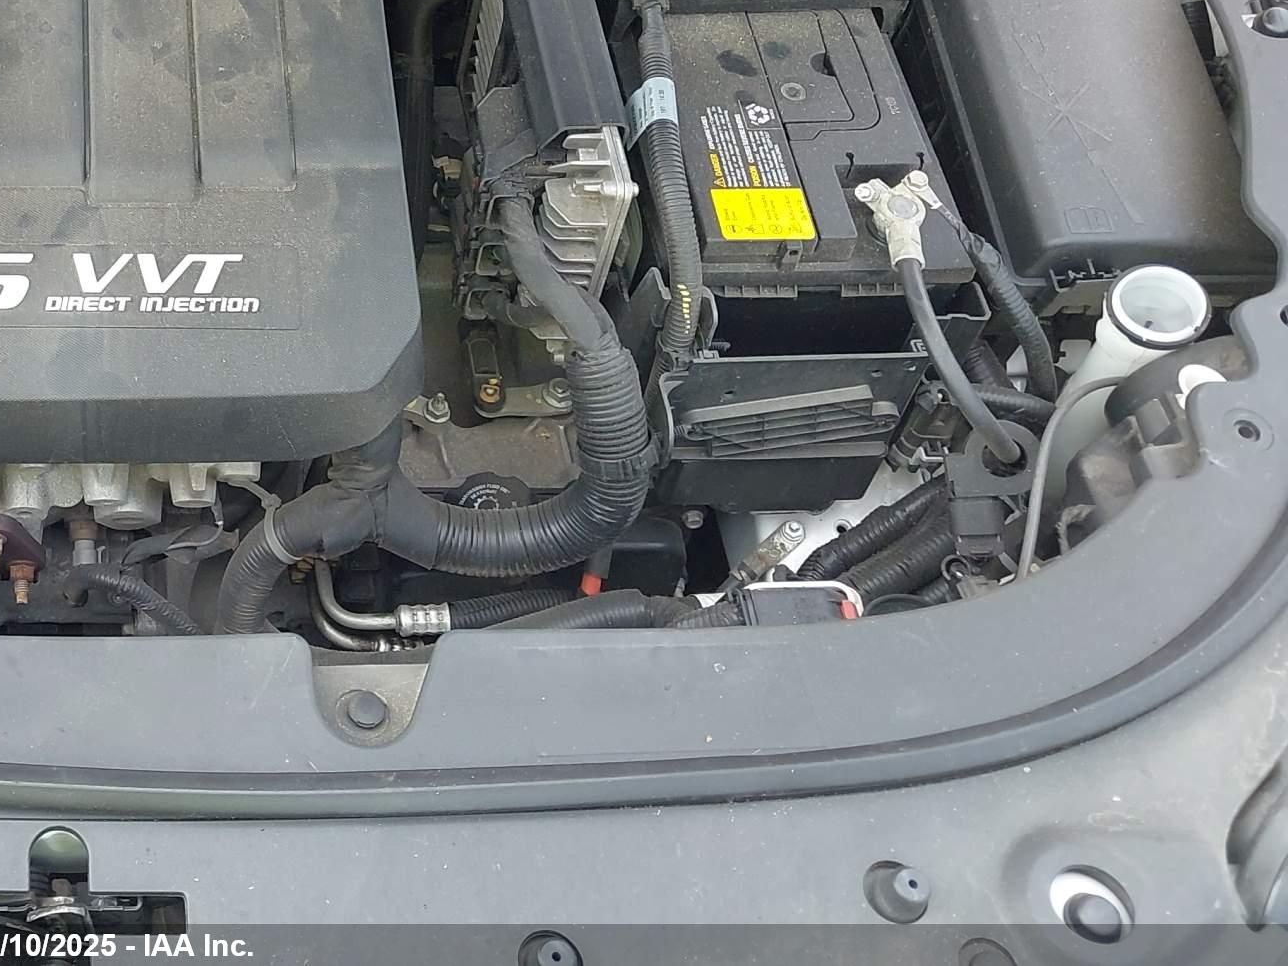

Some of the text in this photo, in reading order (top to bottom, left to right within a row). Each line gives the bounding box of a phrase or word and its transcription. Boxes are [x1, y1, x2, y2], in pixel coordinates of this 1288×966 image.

[710, 154, 723, 176] DANGER
[749, 166, 761, 186] POISON
[72, 253, 243, 294] VVT
[45, 296, 260, 315] DIRECT INJECTION
